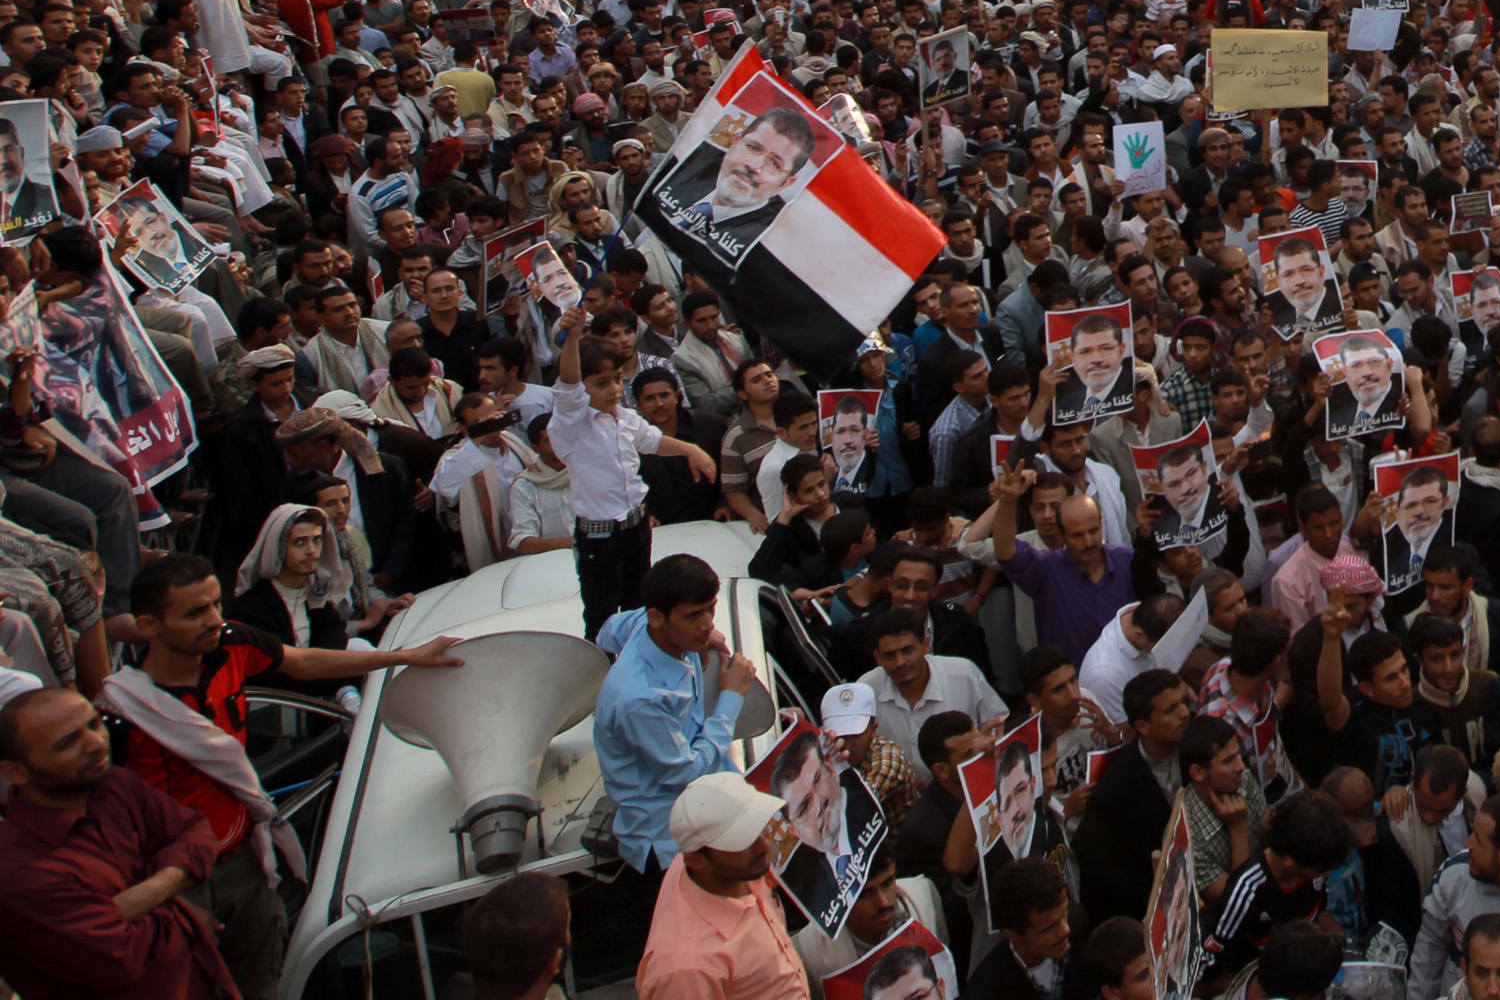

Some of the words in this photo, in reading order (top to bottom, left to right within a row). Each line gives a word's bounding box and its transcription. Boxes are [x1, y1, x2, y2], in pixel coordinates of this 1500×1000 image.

[1151, 159, 1161, 176] لا
[659, 186, 708, 233] الشرعية
[23, 210, 54, 229] نؤيد
[717, 229, 745, 258] كلنا
[1324, 314, 1342, 329] كلنا
[1098, 399, 1113, 417] مع
[1112, 394, 1133, 409] كلنا
[1056, 402, 1100, 421] الشرعية
[1381, 413, 1400, 426] كلنا
[1330, 417, 1371, 435] الشرعية
[1368, 416, 1383, 430] مع
[1208, 513, 1227, 531] كلنا
[1155, 526, 1200, 546] الشرعية
[1197, 524, 1210, 541] مع
[857, 811, 885, 849] كلنا
[852, 847, 866, 873] مع
[820, 865, 859, 929] الشرعية
